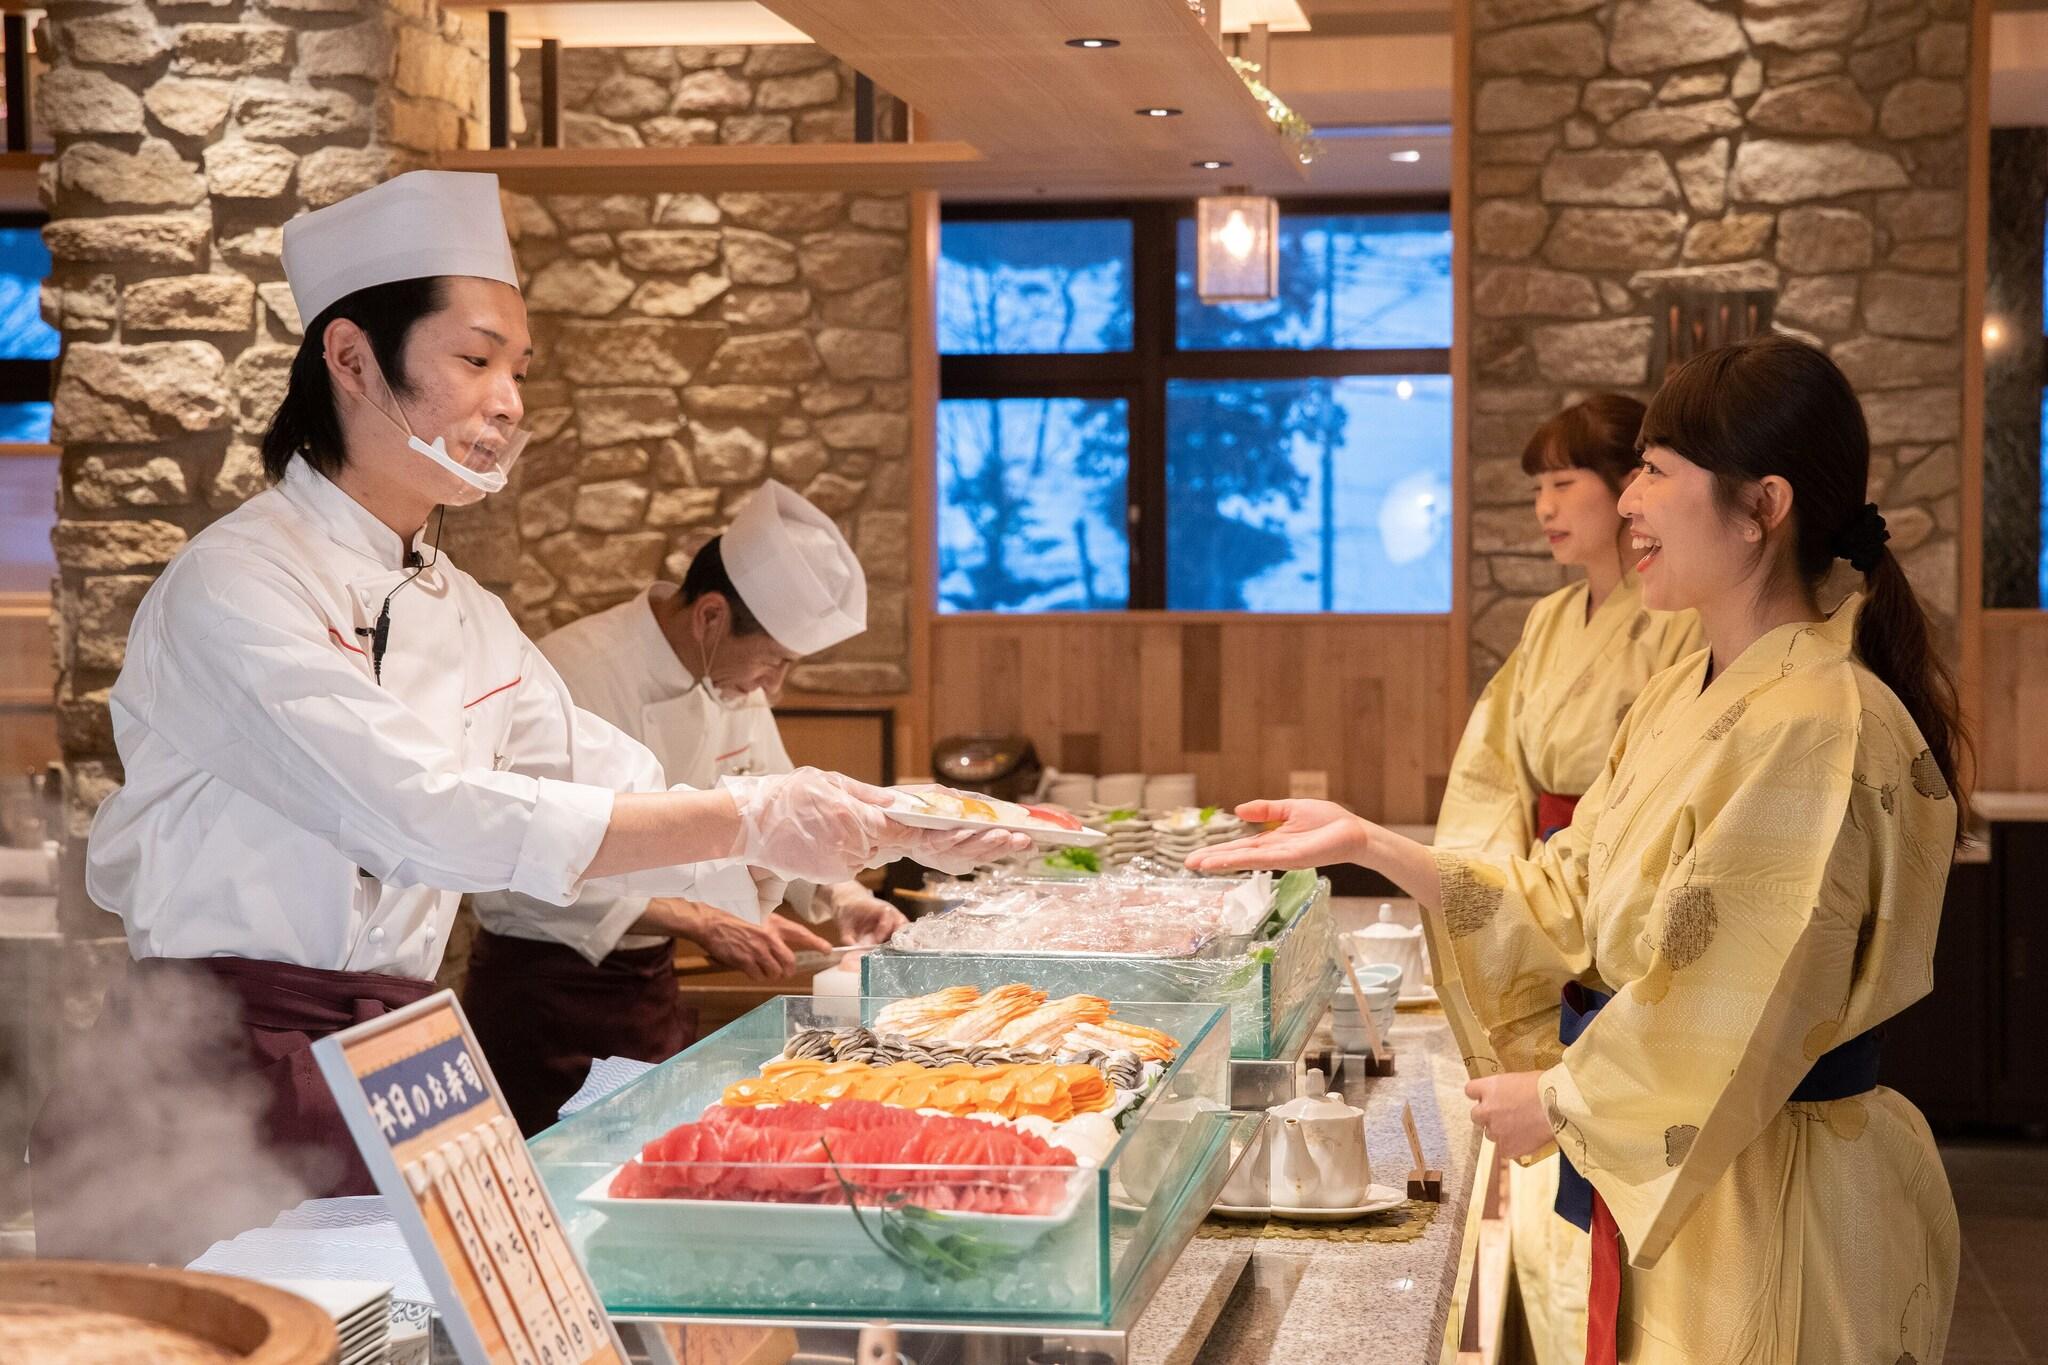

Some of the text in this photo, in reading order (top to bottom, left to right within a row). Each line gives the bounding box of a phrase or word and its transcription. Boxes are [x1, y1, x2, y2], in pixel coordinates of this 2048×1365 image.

[370, 1051, 483, 1138] 本日のお寿司
[485, 1175, 533, 1285] サーモン
